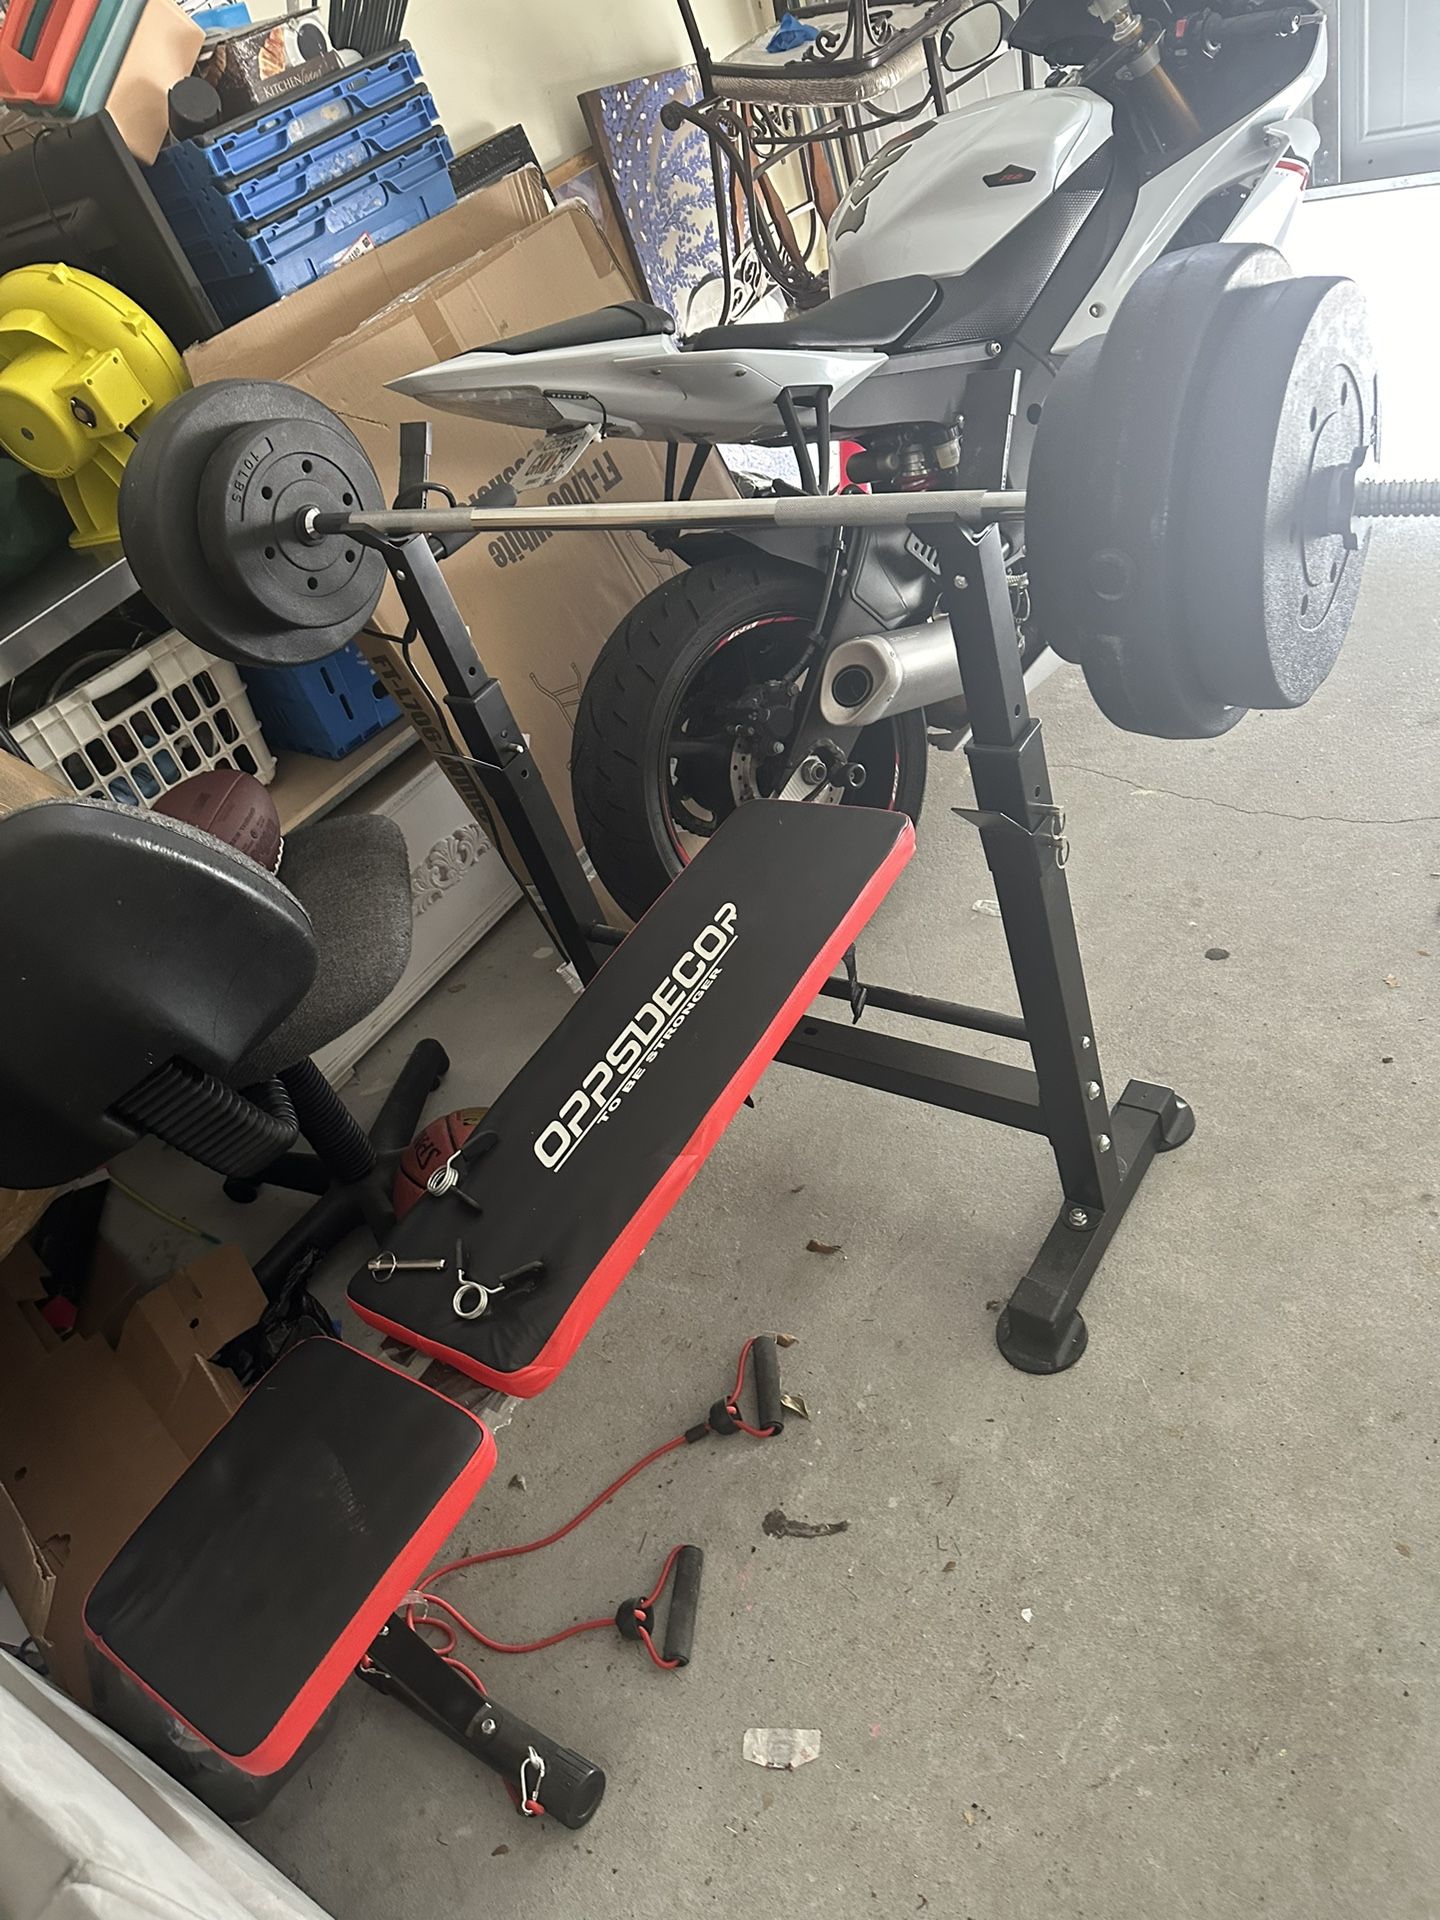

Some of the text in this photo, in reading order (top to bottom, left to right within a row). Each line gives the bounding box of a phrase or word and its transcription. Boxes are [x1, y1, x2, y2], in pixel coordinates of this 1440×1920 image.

[533, 902, 738, 1169] OPPSDECOR
[596, 966, 723, 1124] TO BE STRONGER
